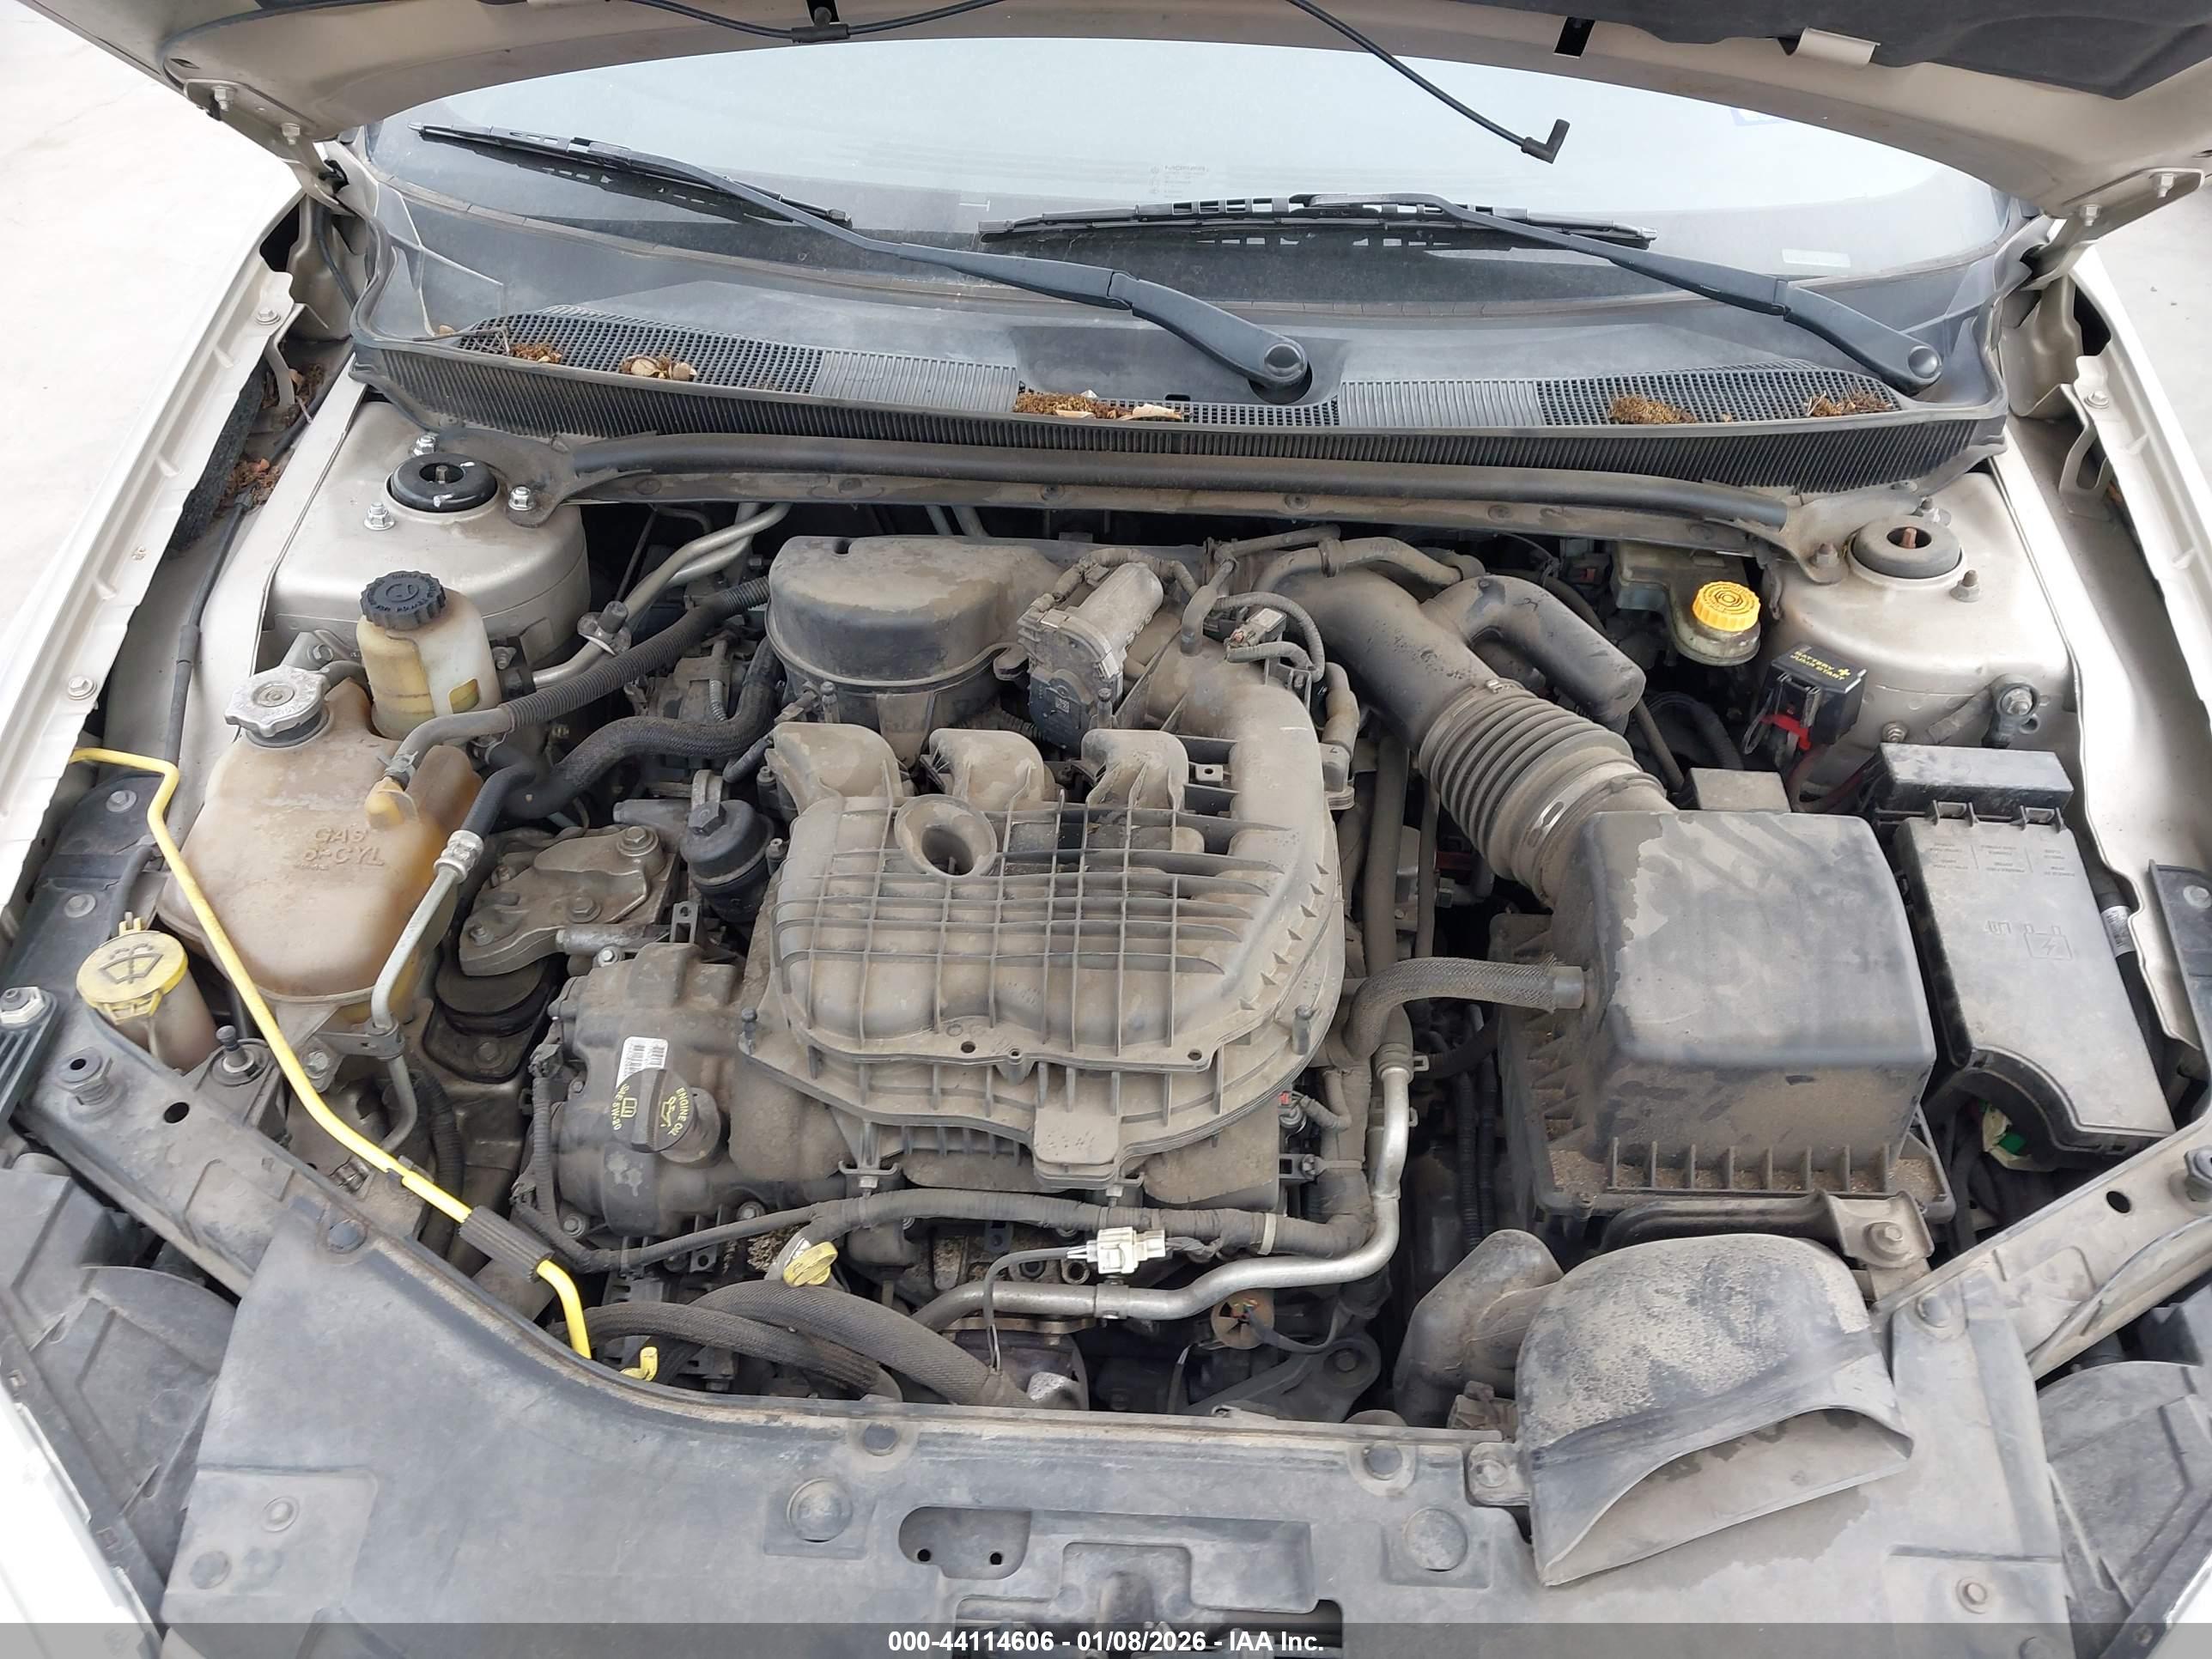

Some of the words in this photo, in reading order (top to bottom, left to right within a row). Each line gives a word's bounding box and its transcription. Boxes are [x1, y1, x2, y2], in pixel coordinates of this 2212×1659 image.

[1790, 654, 1815, 667] JUMP
[1815, 665, 1845, 680] START
[1793, 651, 1834, 671] BATTERY
[614, 1083, 630, 1101] SAE
[675, 1086, 690, 1121] ENGINE
[611, 1102, 623, 1131] 5W-20
[667, 1121, 684, 1136] OIL
